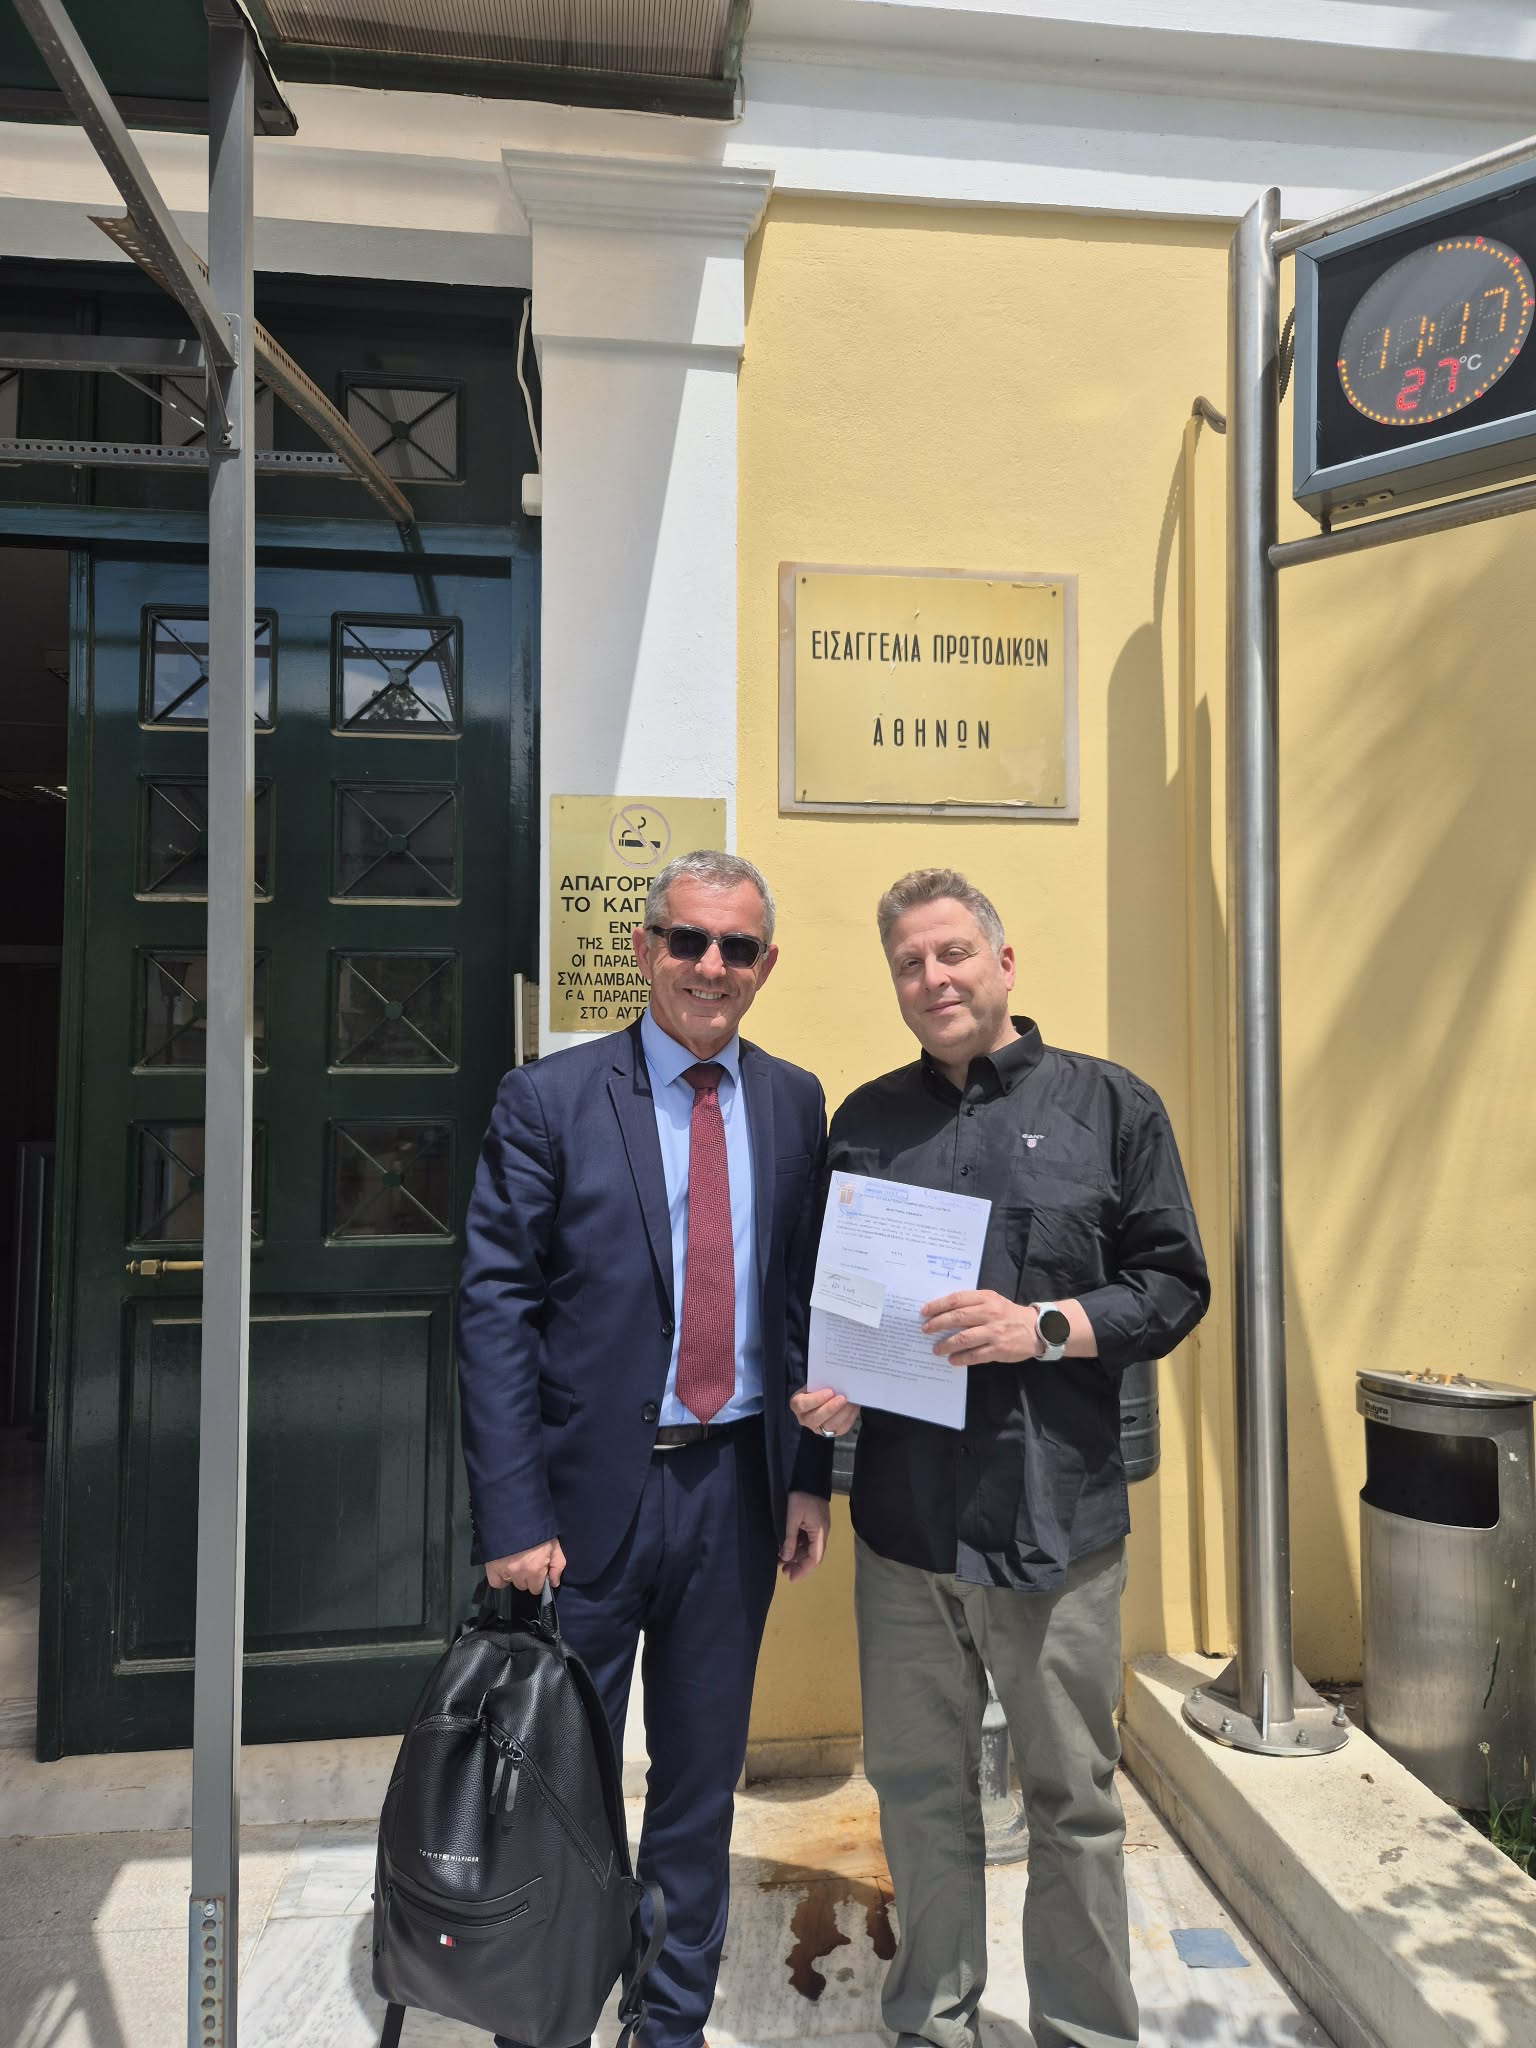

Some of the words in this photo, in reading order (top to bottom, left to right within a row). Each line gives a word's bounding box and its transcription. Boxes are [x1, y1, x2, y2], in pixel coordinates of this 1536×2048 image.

[811, 630, 922, 663] ΕΙΣΑΓΓΕΛΙΑ
[932, 633, 1049, 667] ΠΡΩΤΟΔΙΚΩΝ
[873, 717, 990, 750] ΑΘΗΝΩΝ
[560, 896, 591, 913] ΤΟ
[576, 936, 604, 950] ΤΗΣ
[611, 937, 635, 951] ΕΙΣ
[571, 953, 586, 968] ΟΙ
[593, 989, 651, 1003] ΠΑΡΑΠΕ
[580, 1006, 608, 1020] ΣΤΟ
[418, 1848, 443, 1860] TOMMY
